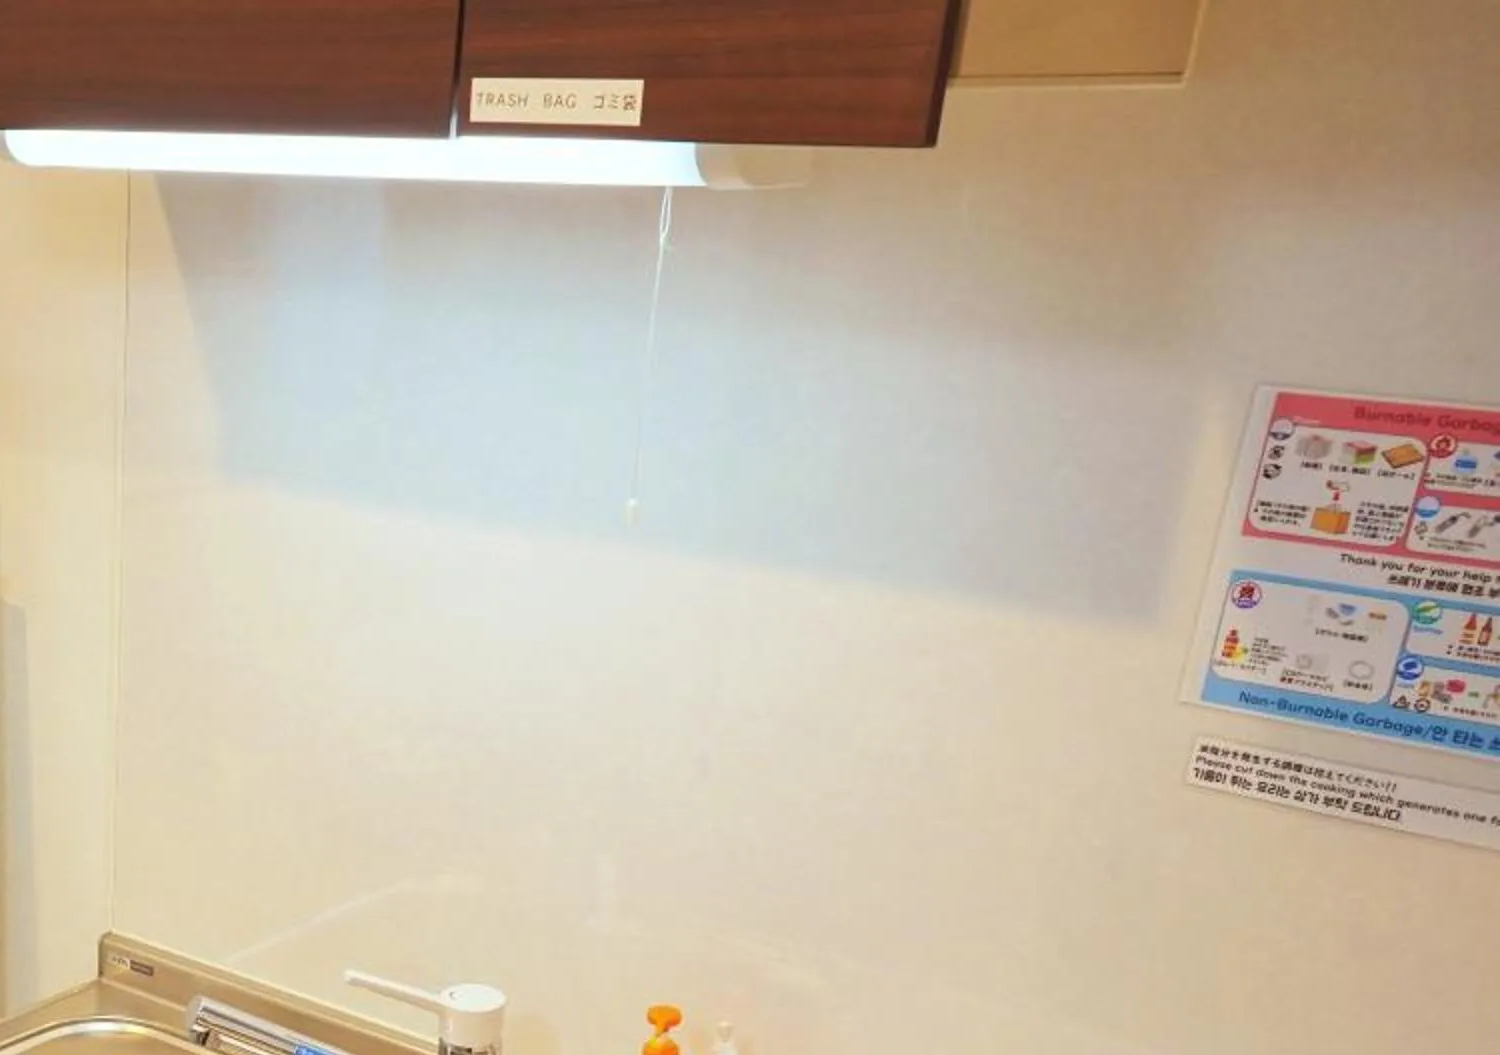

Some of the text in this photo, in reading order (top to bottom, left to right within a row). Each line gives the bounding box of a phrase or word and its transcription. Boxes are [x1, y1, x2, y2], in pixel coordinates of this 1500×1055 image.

[476, 92, 529, 107] TRASH
[543, 94, 577, 109] BAG
[1354, 406, 1431, 427] Burnable
[1340, 553, 1492, 584] Thank you for your help
[1239, 690, 1348, 721] Non-Burnable
[1195, 755, 1232, 770] Please
[1235, 764, 1253, 774] cut
[1256, 769, 1285, 781] down
[1289, 775, 1307, 787] the
[1310, 781, 1356, 799] cooking
[1359, 791, 1394, 804] which
[1397, 799, 1460, 818] generates
